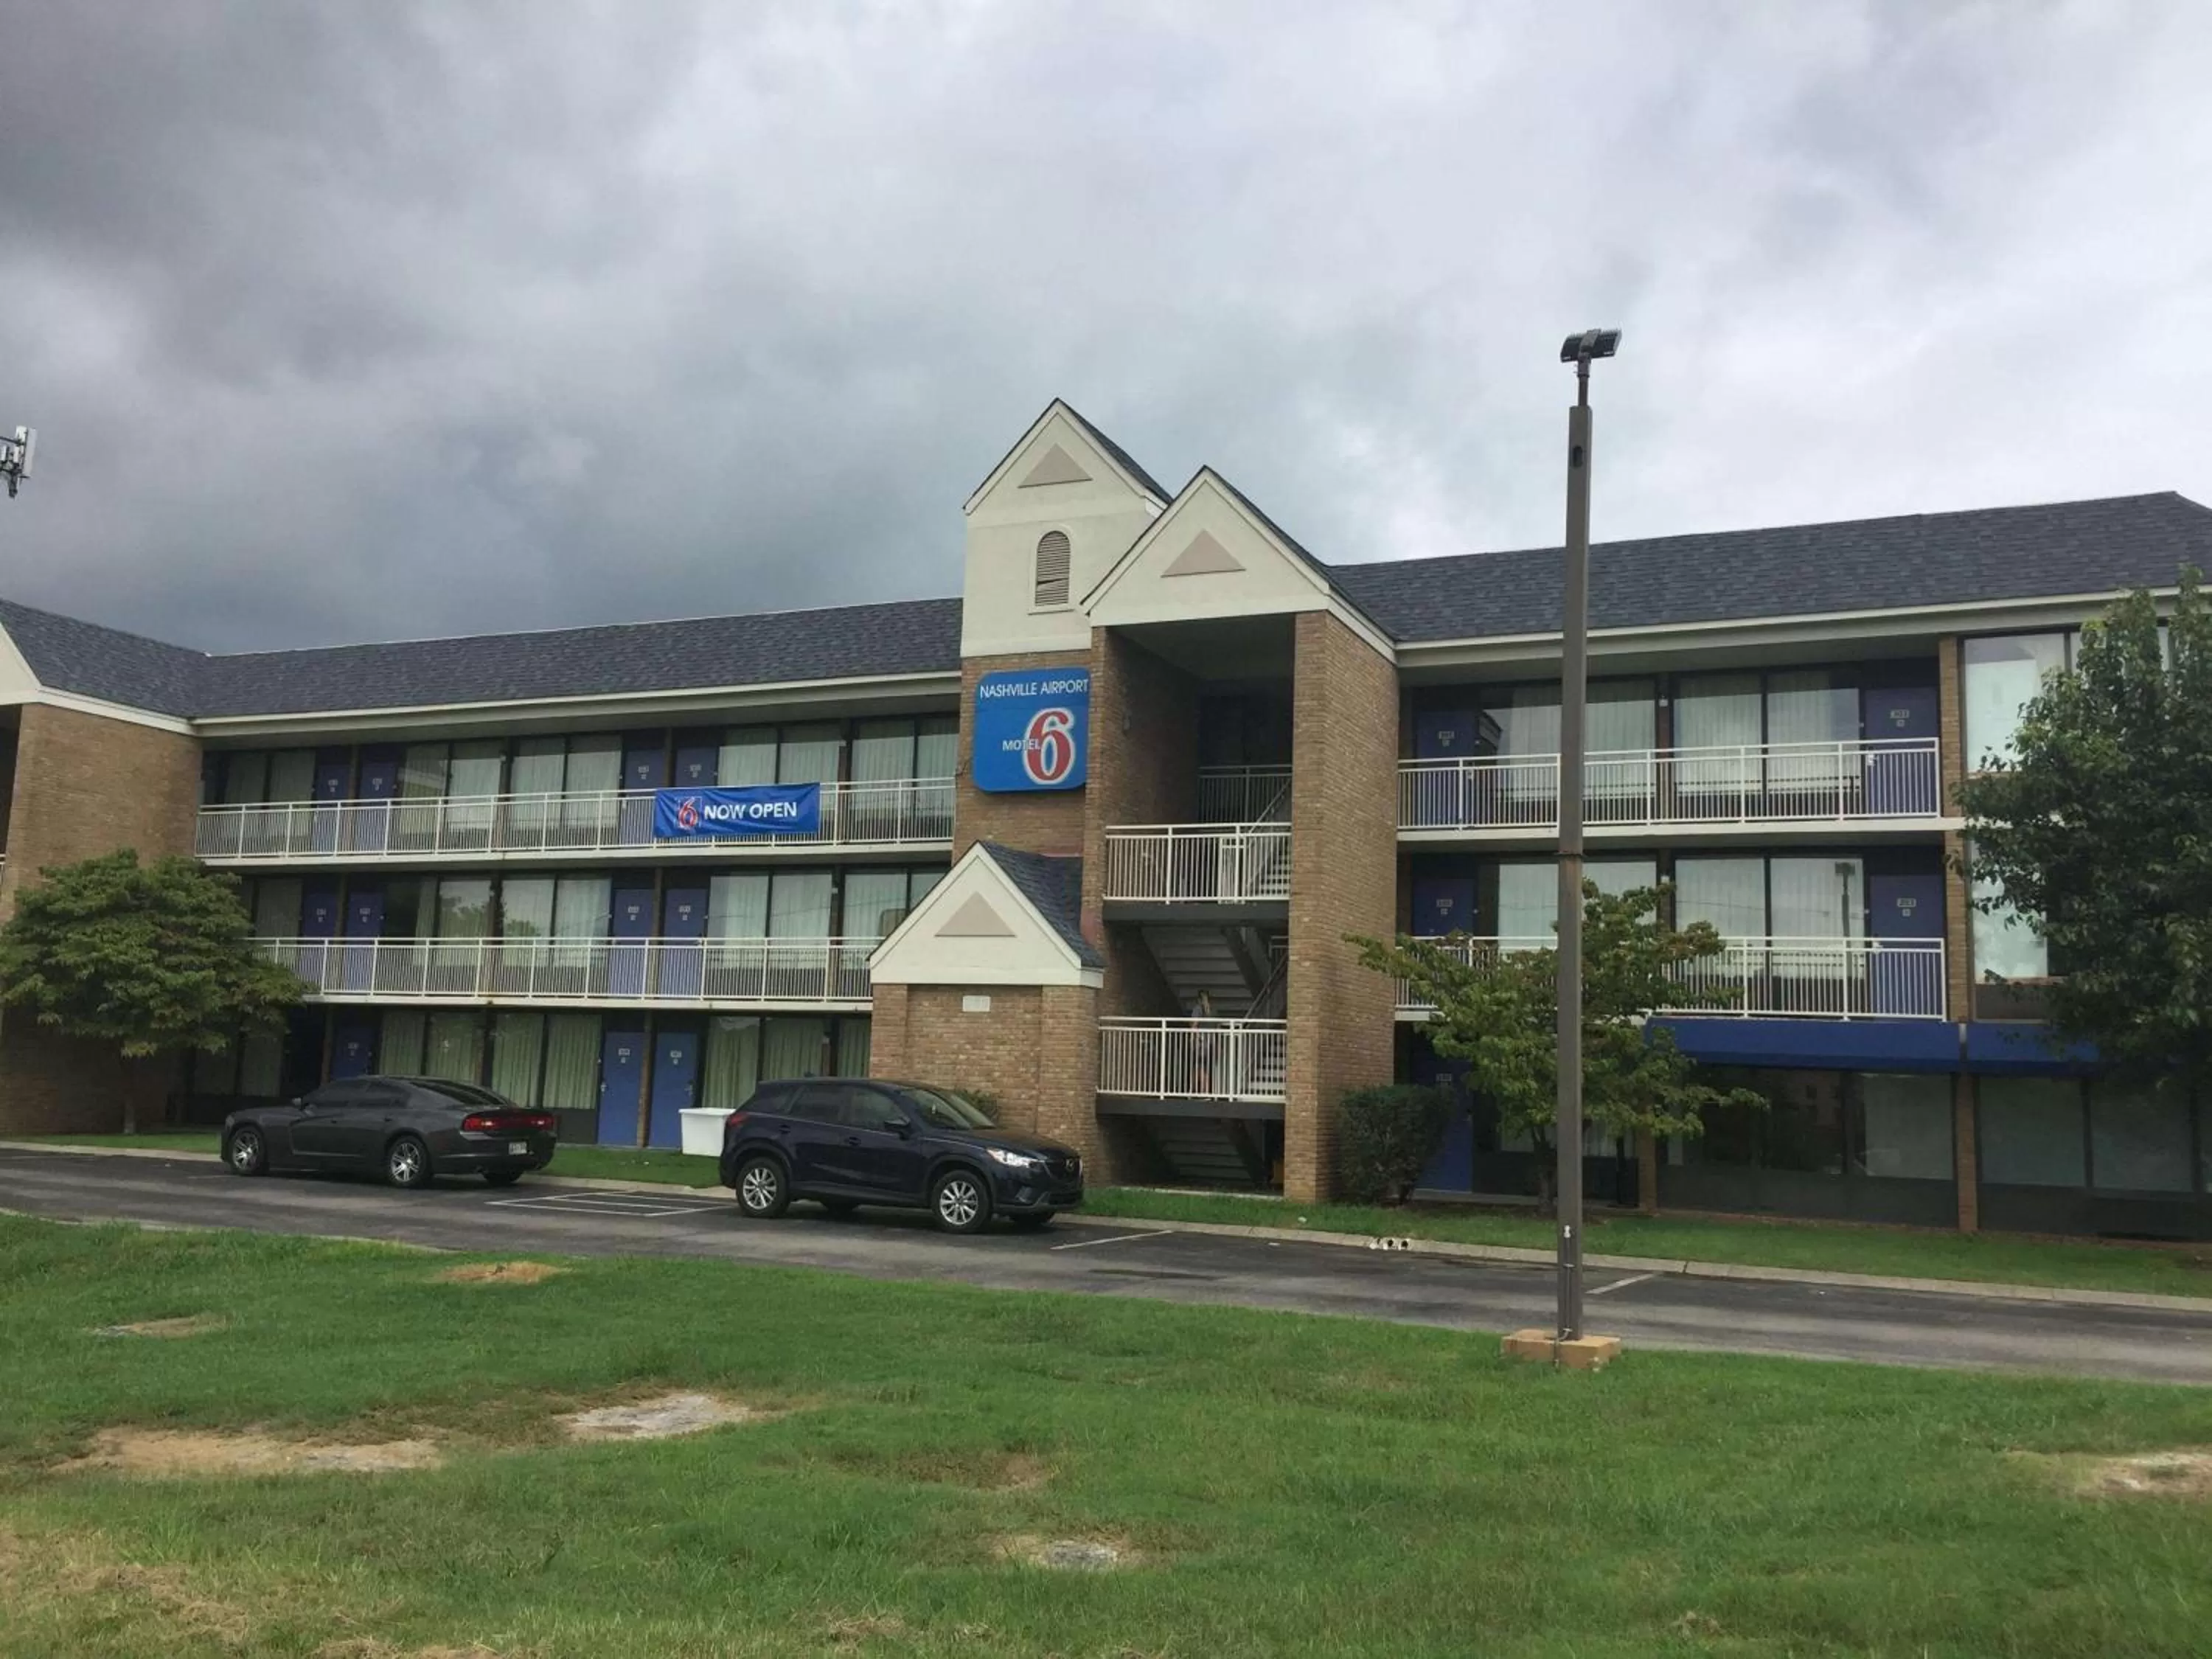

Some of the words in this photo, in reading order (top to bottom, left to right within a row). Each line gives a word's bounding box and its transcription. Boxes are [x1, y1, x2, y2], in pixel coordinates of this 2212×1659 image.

[980, 682, 1037, 699] NASHVILLE
[1040, 678, 1089, 695] AIRPORT
[1003, 739, 1040, 751] MOTEL
[1023, 707, 1075, 785] 6
[704, 804, 746, 820] NOW
[749, 801, 797, 818] OPEN
